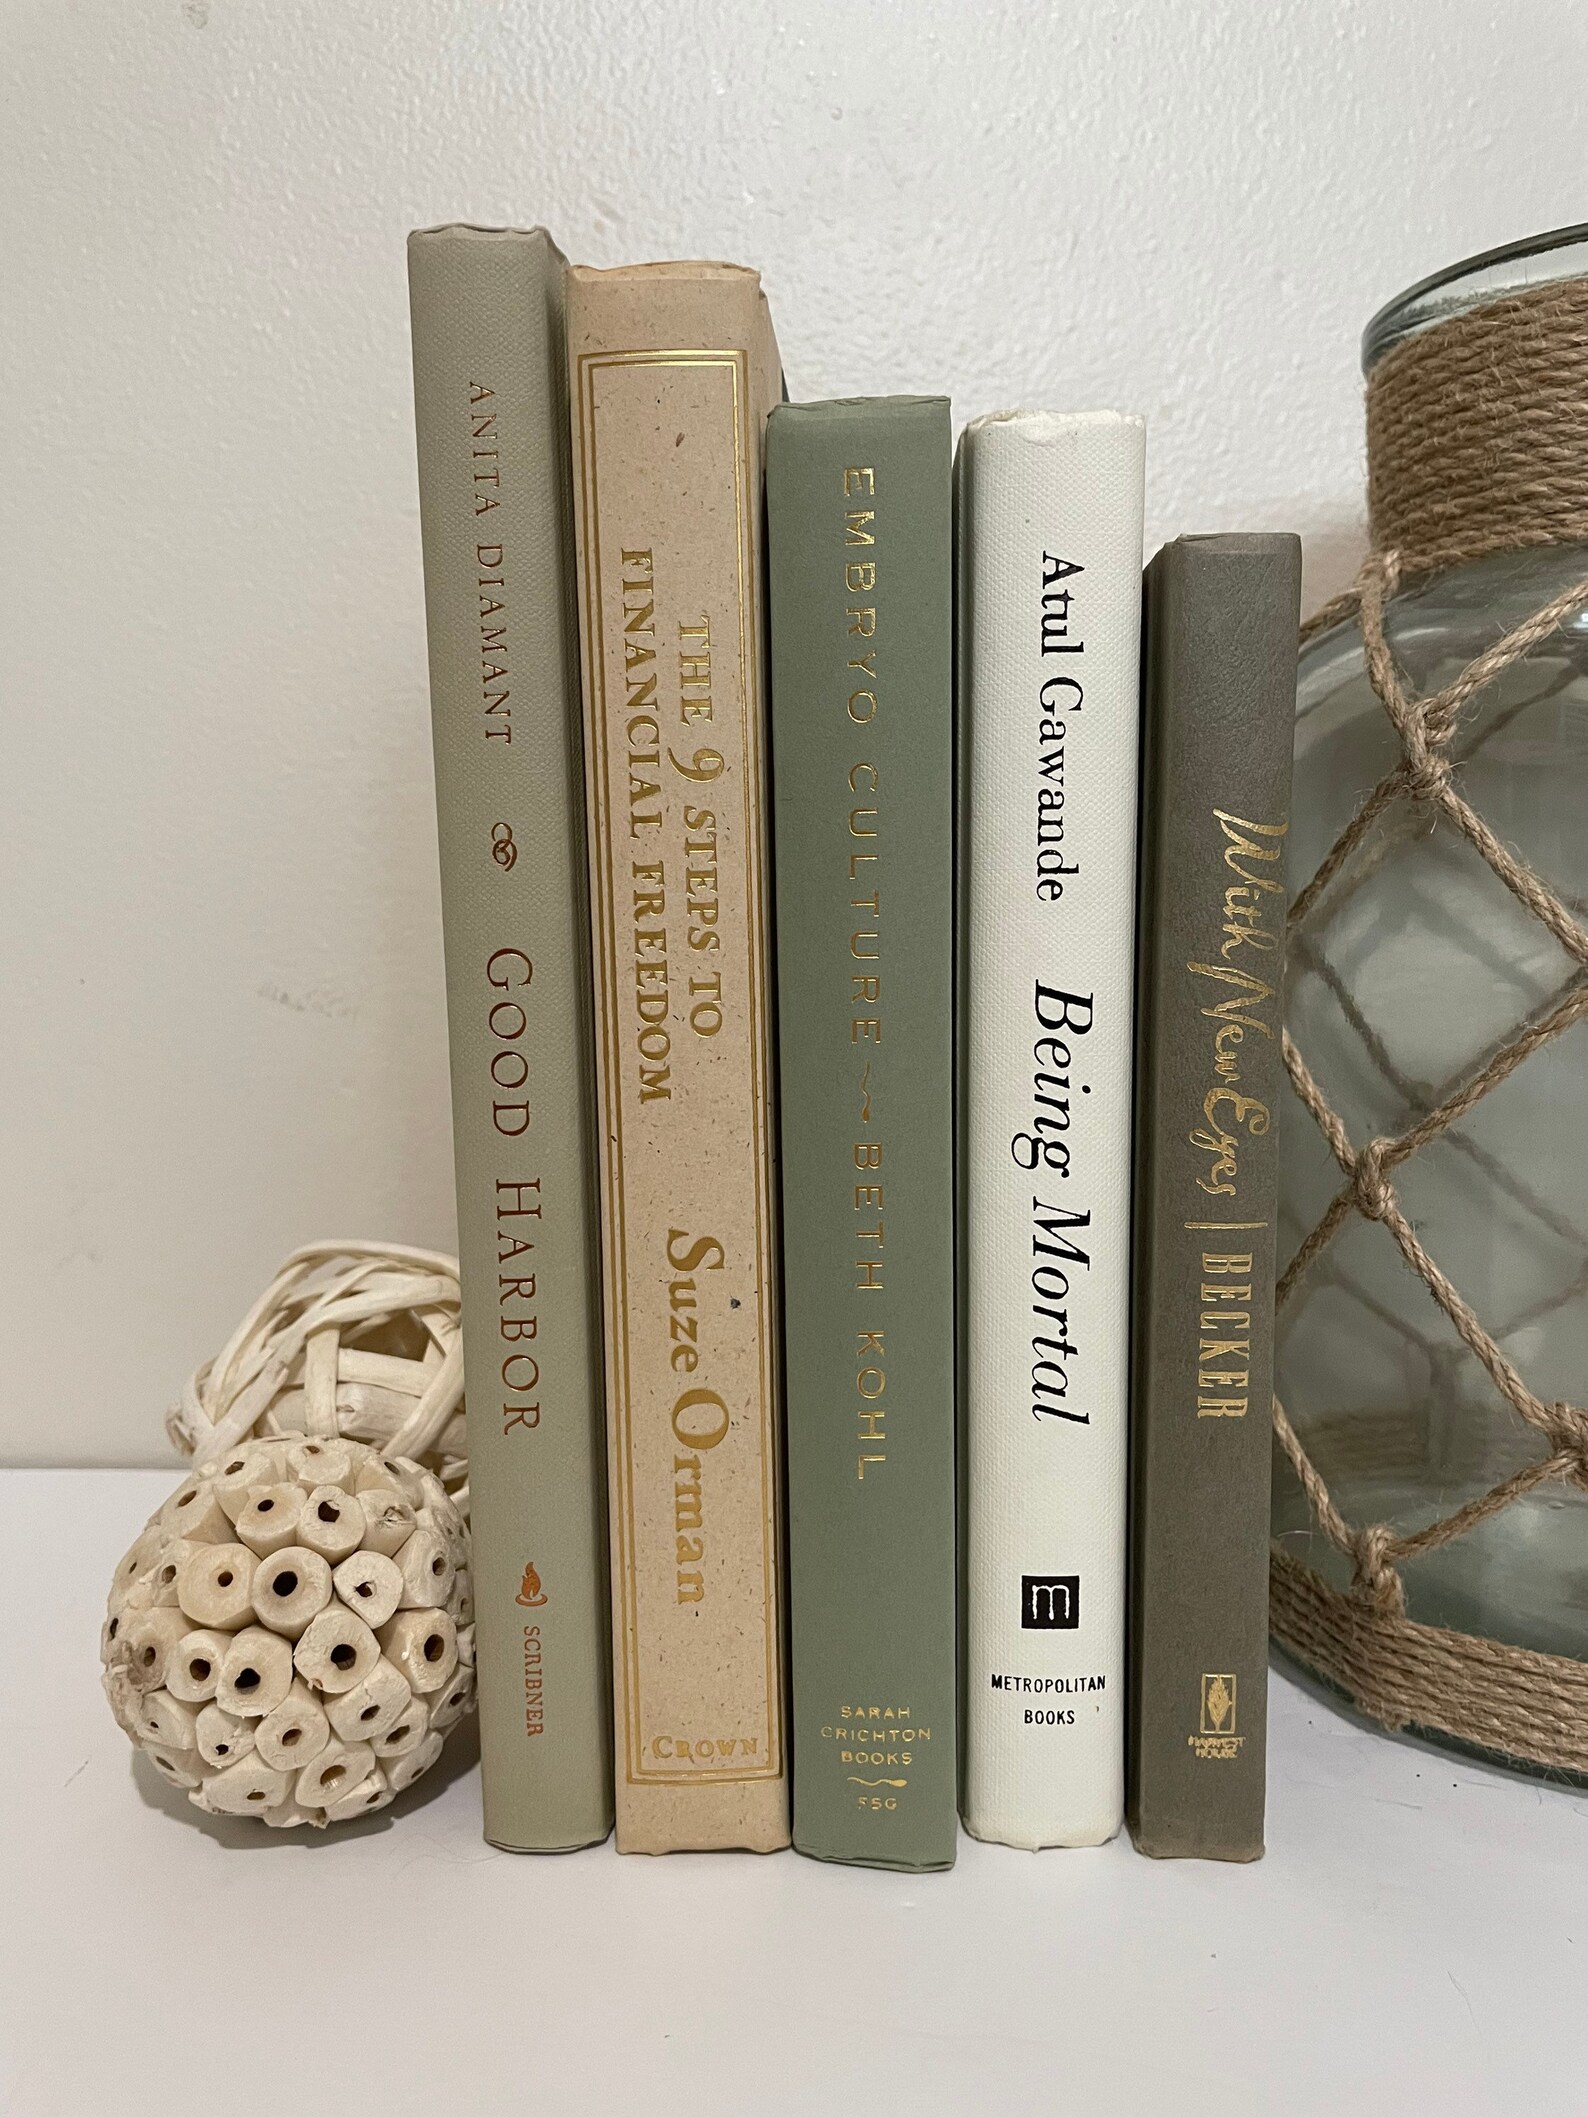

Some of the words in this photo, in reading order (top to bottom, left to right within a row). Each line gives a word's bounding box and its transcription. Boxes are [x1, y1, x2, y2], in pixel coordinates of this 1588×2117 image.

[470, 381, 500, 516] ANITA
[477, 544, 512, 745] DIAMANT
[844, 467, 877, 723] EMBRYO
[1041, 550, 1085, 657] Atul
[621, 547, 663, 839] FINANCIAL
[678, 614, 713, 726] THE
[667, 747, 725, 783] 9
[1036, 676, 1084, 901] Gawande
[684, 805, 721, 951] STEPS
[848, 762, 881, 1044] CULTURE
[1213, 808, 1288, 960] With
[486, 948, 533, 1136] GOOD
[632, 860, 671, 1104] FREEDOM
[688, 972, 723, 1038] TO
[1187, 961, 1275, 1083] New
[1011, 979, 1094, 1178] Being
[1189, 1087, 1270, 1196] Eyes
[854, 1142, 884, 1290] BETH
[496, 1177, 542, 1435] HARBOR
[667, 1228, 725, 1373] Suze
[1031, 1195, 1091, 1425] Mortal
[1197, 1252, 1253, 1419] BECKER
[856, 1330, 886, 1480] KOHL
[671, 1388, 730, 1605] Orman
[523, 1625, 544, 1737] SCRIBNER
[652, 1735, 759, 1760] CROWN
[820, 1726, 931, 1743] CRICHTON
[841, 1705, 911, 1719] SARAH
[991, 1673, 1106, 1693] METROPOLITAN
[1024, 1709, 1076, 1725] BOOKS
[841, 1750, 913, 1766] BOOKS
